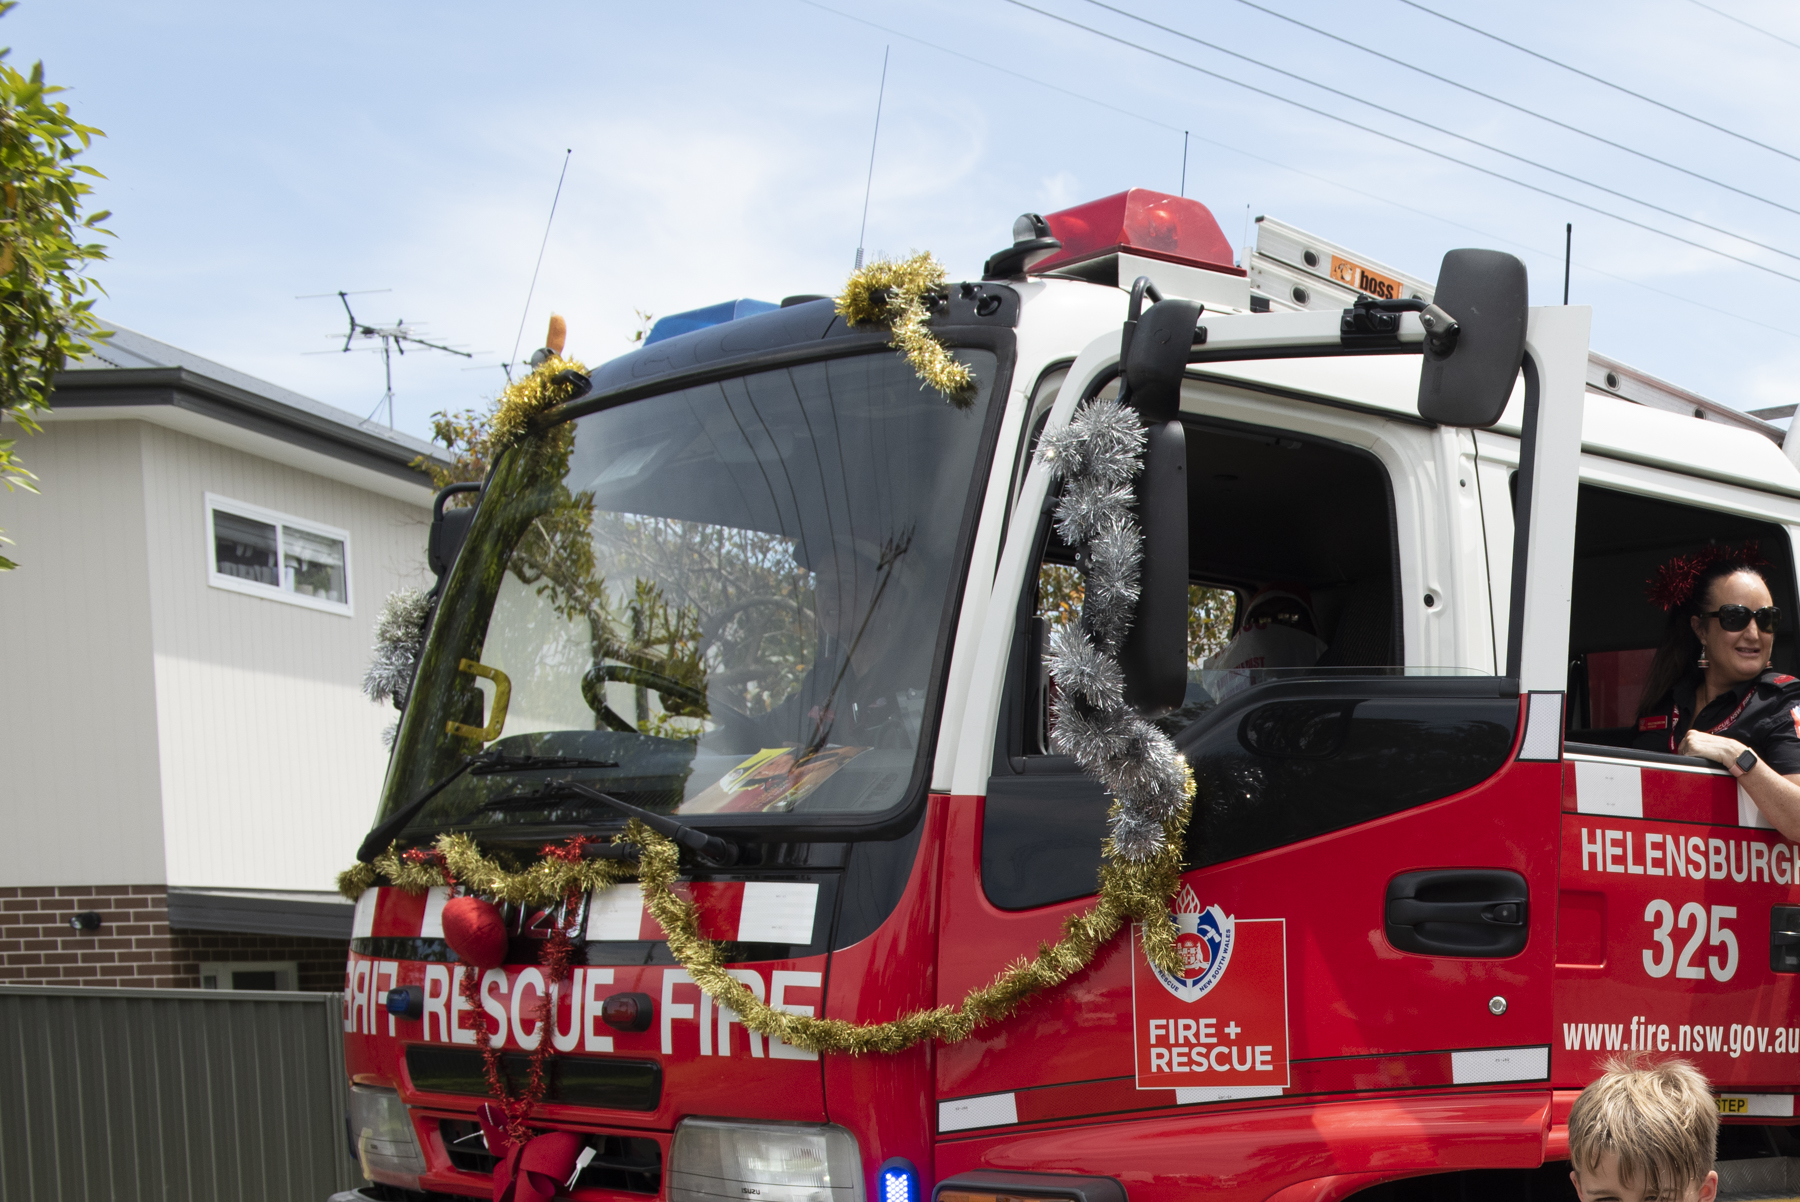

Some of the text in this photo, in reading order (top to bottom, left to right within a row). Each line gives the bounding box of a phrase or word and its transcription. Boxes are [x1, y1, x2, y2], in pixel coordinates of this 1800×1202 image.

[1360, 270, 1394, 299] boss
[1642, 899, 1739, 982] 325
[1199, 928, 1231, 993] NEW SOUTH WALES
[423, 964, 615, 1053] RESCUE
[660, 968, 822, 1061] FIRE
[1150, 1019, 1217, 1044] FIRE
[1563, 1016, 1800, 1058] www.fire.nsw.gov.au
[1150, 1045, 1273, 1072] RESCUE
[1715, 1098, 1745, 1112] STEP
[741, 1187, 761, 1195] ISUZU
